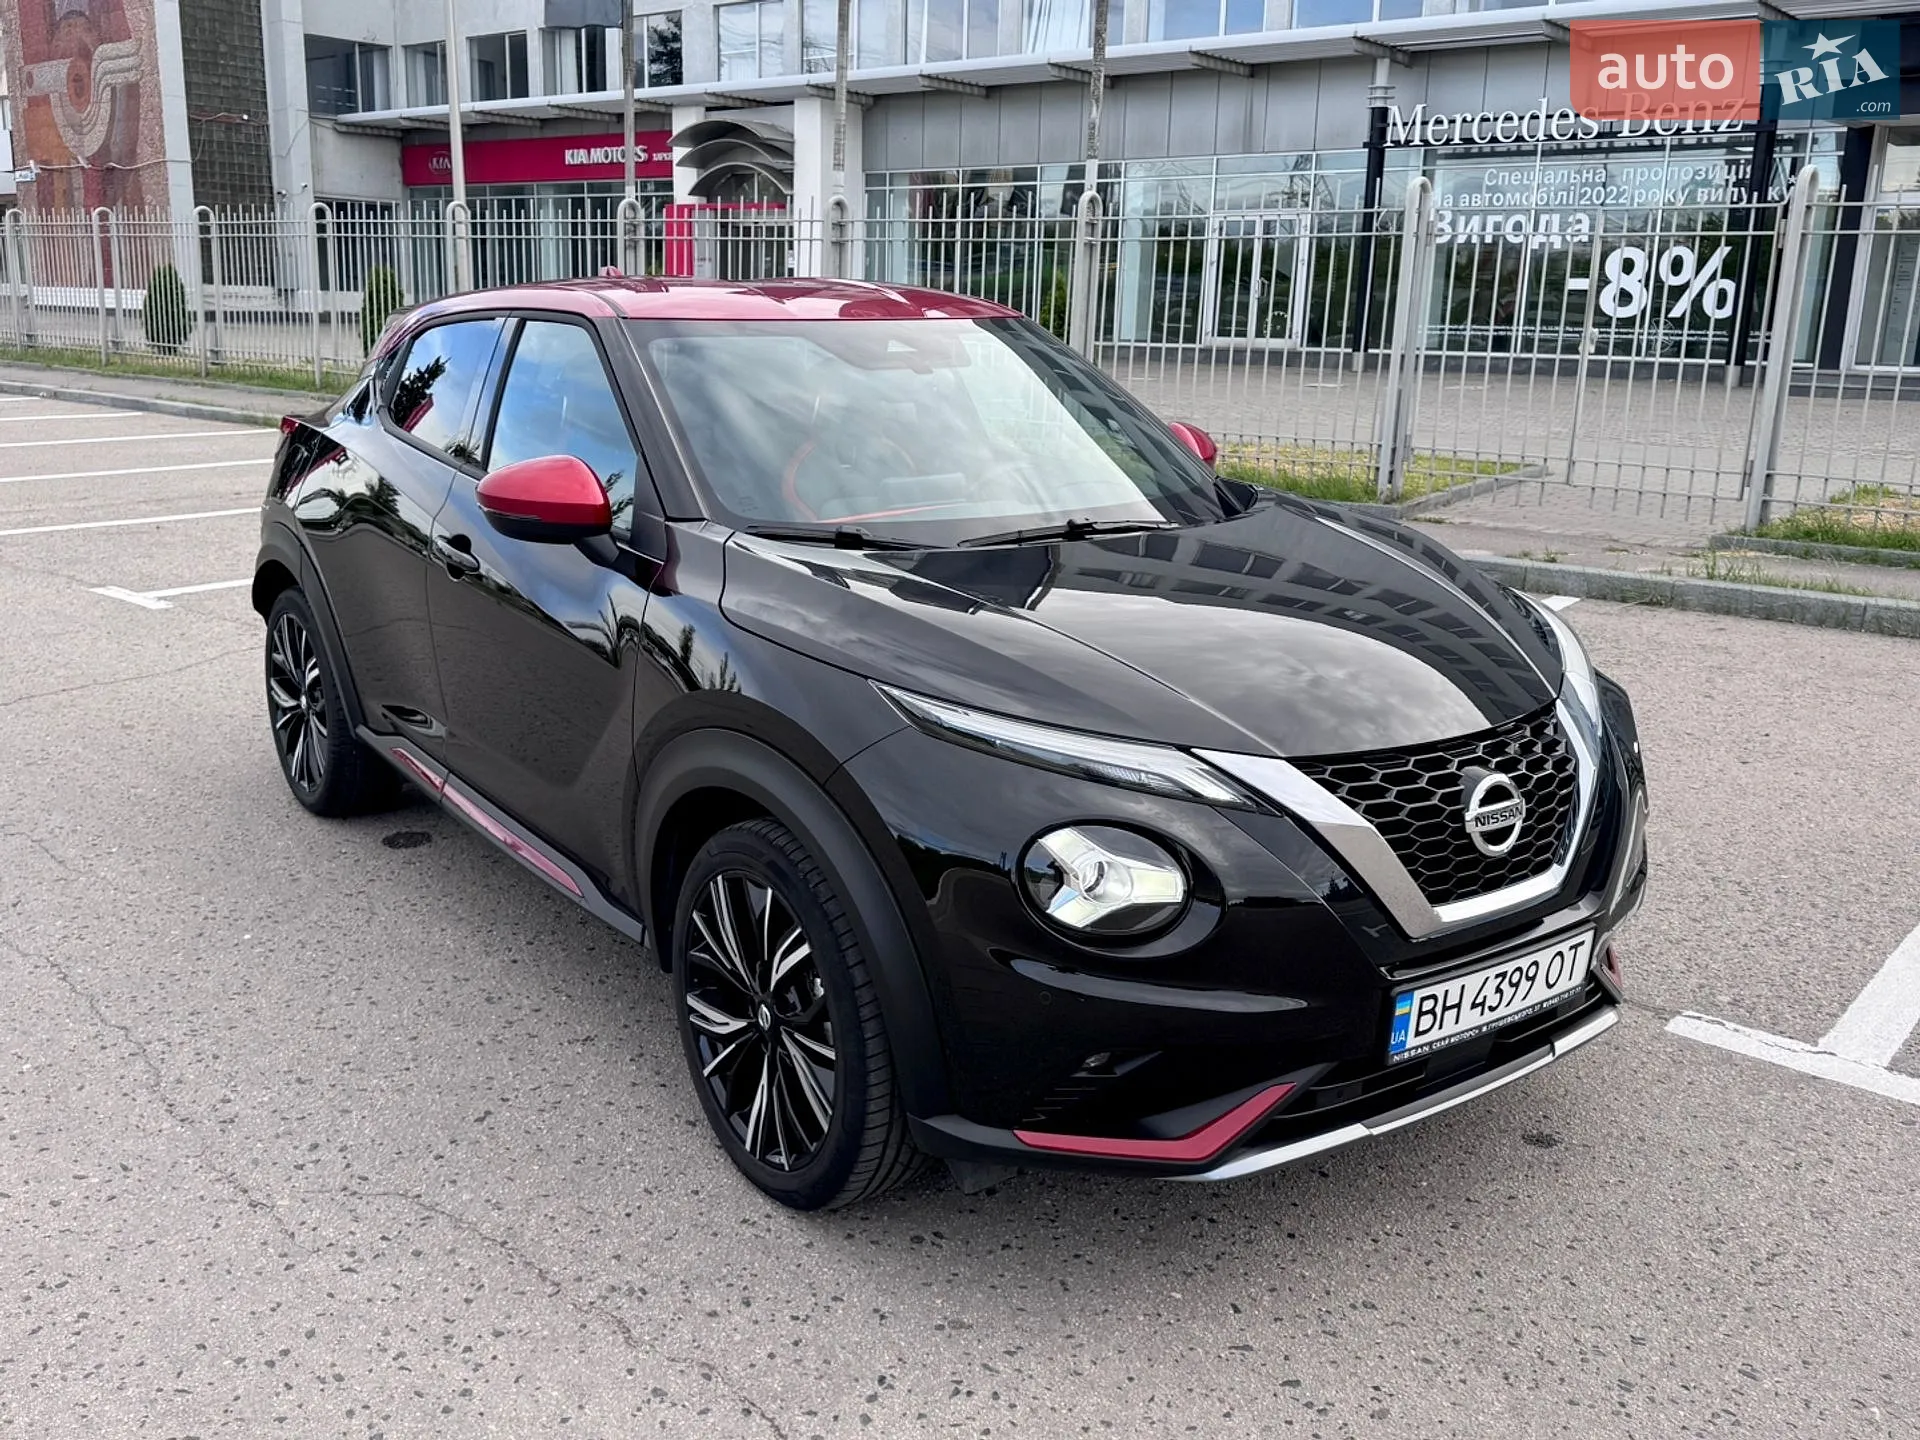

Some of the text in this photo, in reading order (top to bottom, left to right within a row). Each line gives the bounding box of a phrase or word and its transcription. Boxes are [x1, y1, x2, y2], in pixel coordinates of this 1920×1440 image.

[1384, 91, 1748, 147] Mercedes-Benz
[564, 149, 588, 165] KIA
[589, 145, 648, 163] MOTOS
[1579, 185, 1629, 205] 2022
[1633, 185, 1688, 208] року
[1567, 246, 1737, 319] -8%
[1474, 806, 1522, 828] NISSAN
[1414, 983, 1466, 1038] BH
[1470, 960, 1540, 1017] 4399
[1545, 940, 1585, 990] OT
[1391, 1031, 1406, 1045] UA
[1393, 1046, 1430, 1062] NISSAN
